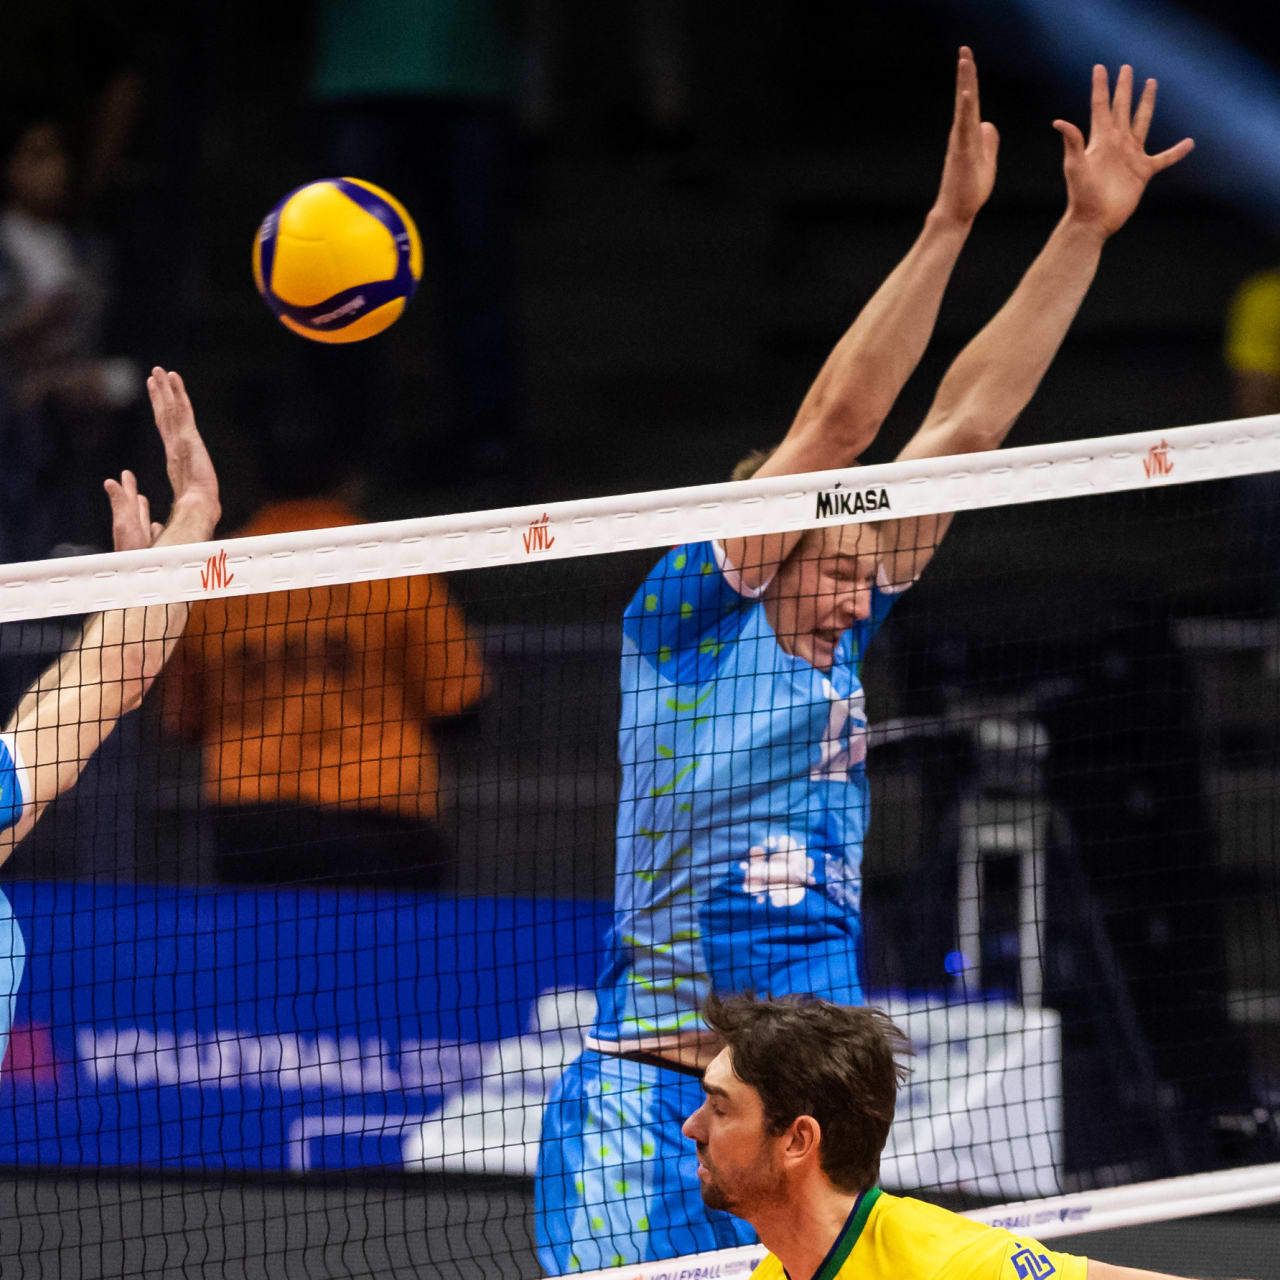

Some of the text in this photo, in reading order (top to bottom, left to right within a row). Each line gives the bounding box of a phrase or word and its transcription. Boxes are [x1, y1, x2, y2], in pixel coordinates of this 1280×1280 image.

[816, 487, 891, 519] MIKASA
[523, 512, 555, 554] VNL
[201, 549, 234, 590] VNL
